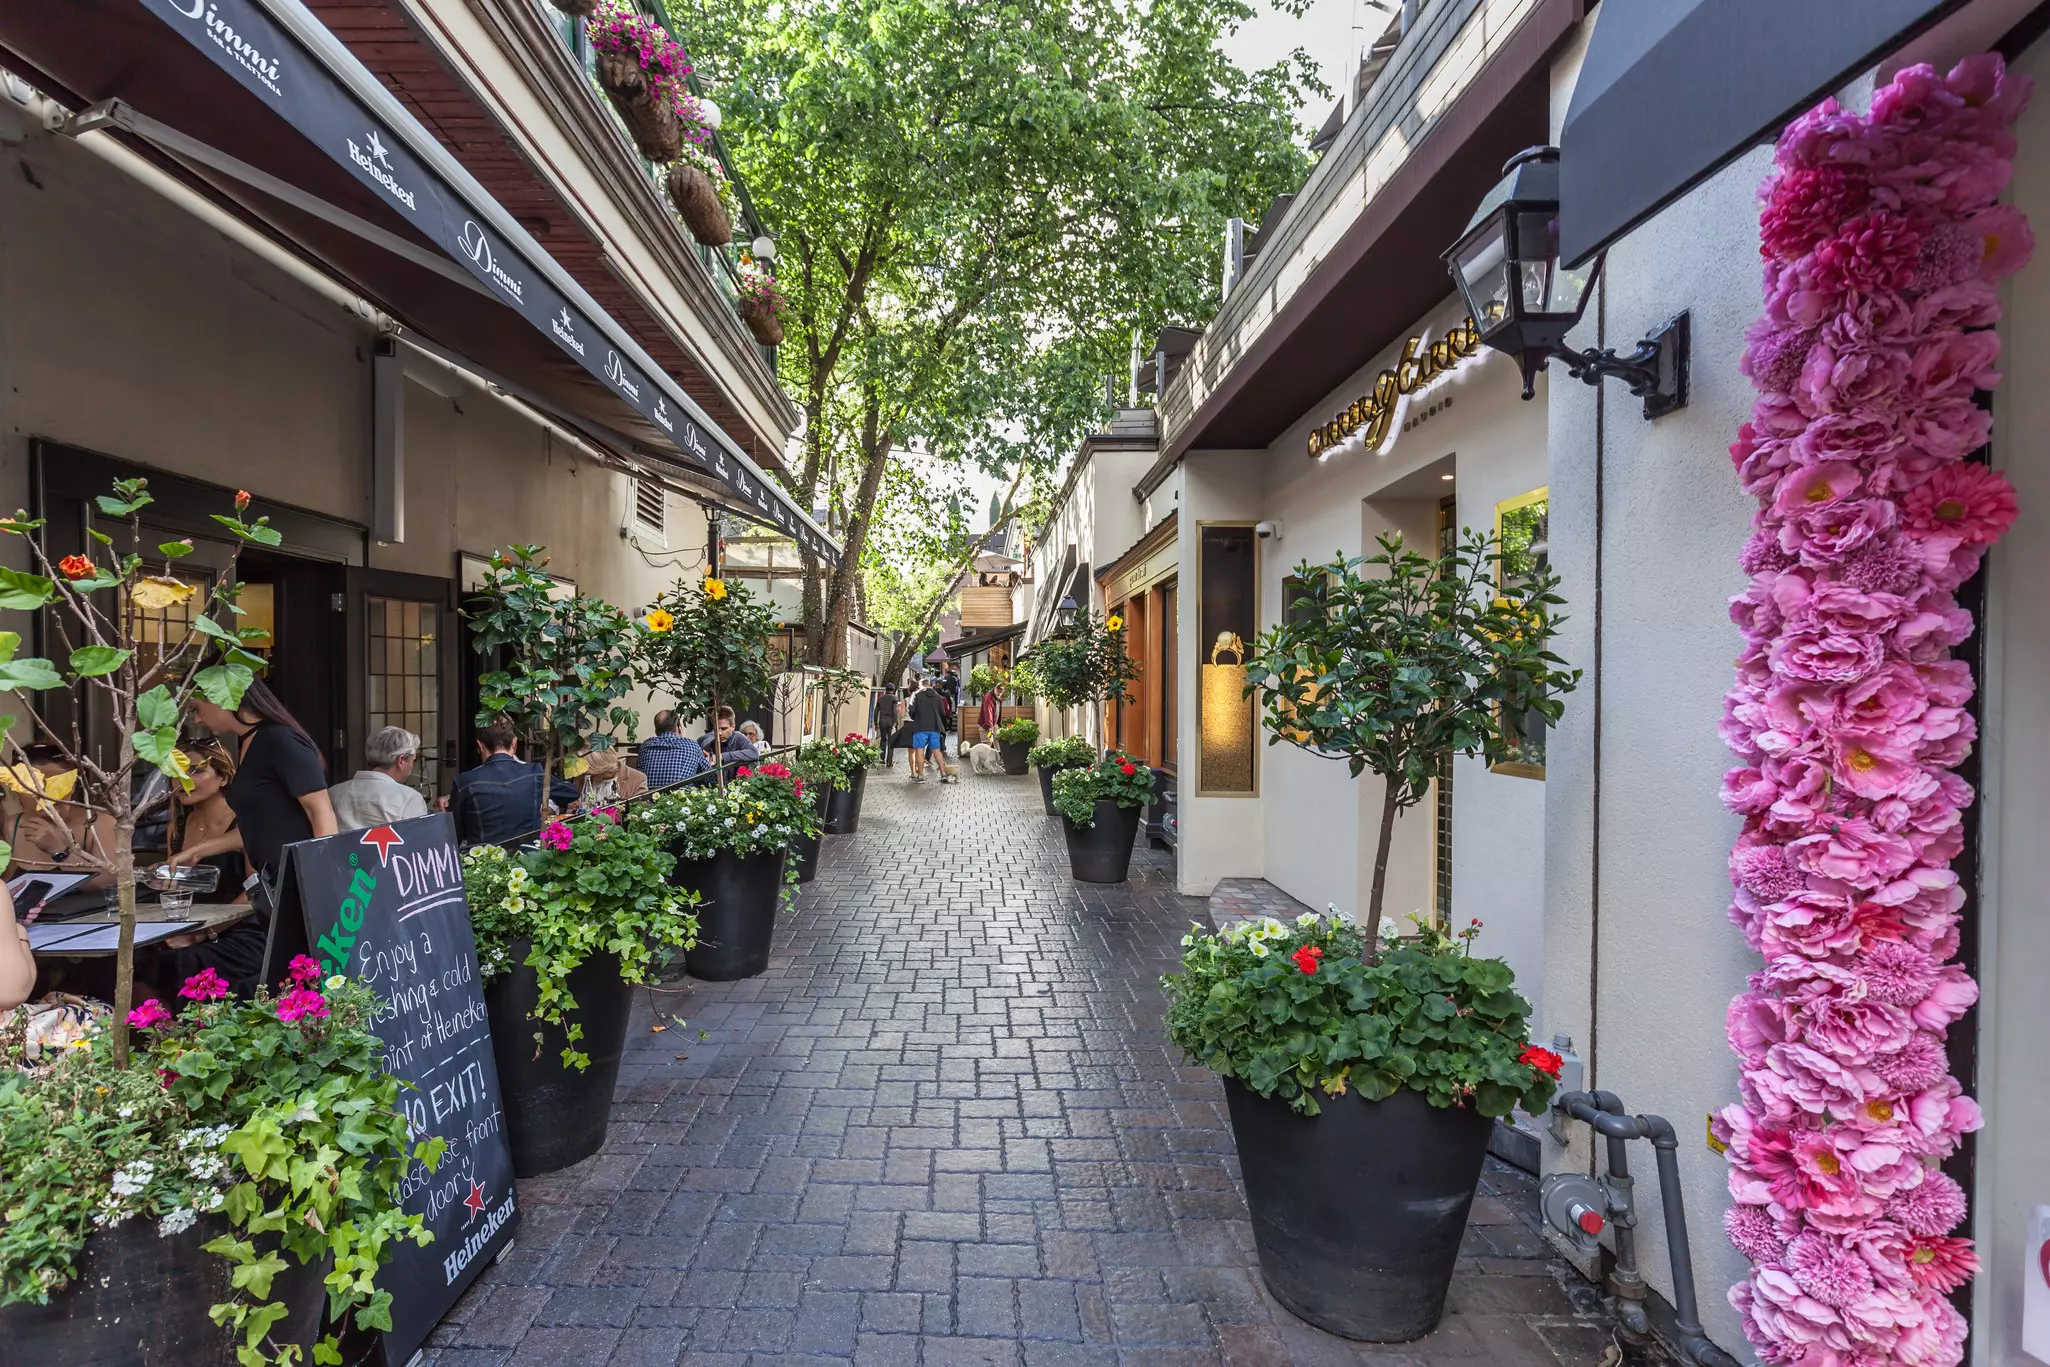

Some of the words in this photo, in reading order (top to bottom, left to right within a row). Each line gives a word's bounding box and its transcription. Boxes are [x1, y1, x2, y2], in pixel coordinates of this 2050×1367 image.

[167, 0, 280, 80] immi
[346, 138, 417, 211] Heineken
[457, 220, 523, 296] Dimmi
[552, 318, 585, 356] Heineken
[604, 349, 639, 397] Dimmi
[391, 842, 462, 897] DIMMI
[359, 940, 417, 983] Enjoy
[420, 932, 432, 954] a
[443, 952, 472, 991] cold
[421, 1023, 433, 1050] of
[429, 1059, 487, 1125] EXIT!
[465, 1102, 501, 1148] front
[426, 1172, 461, 1222] door
[443, 1195, 516, 1287] Heineken
